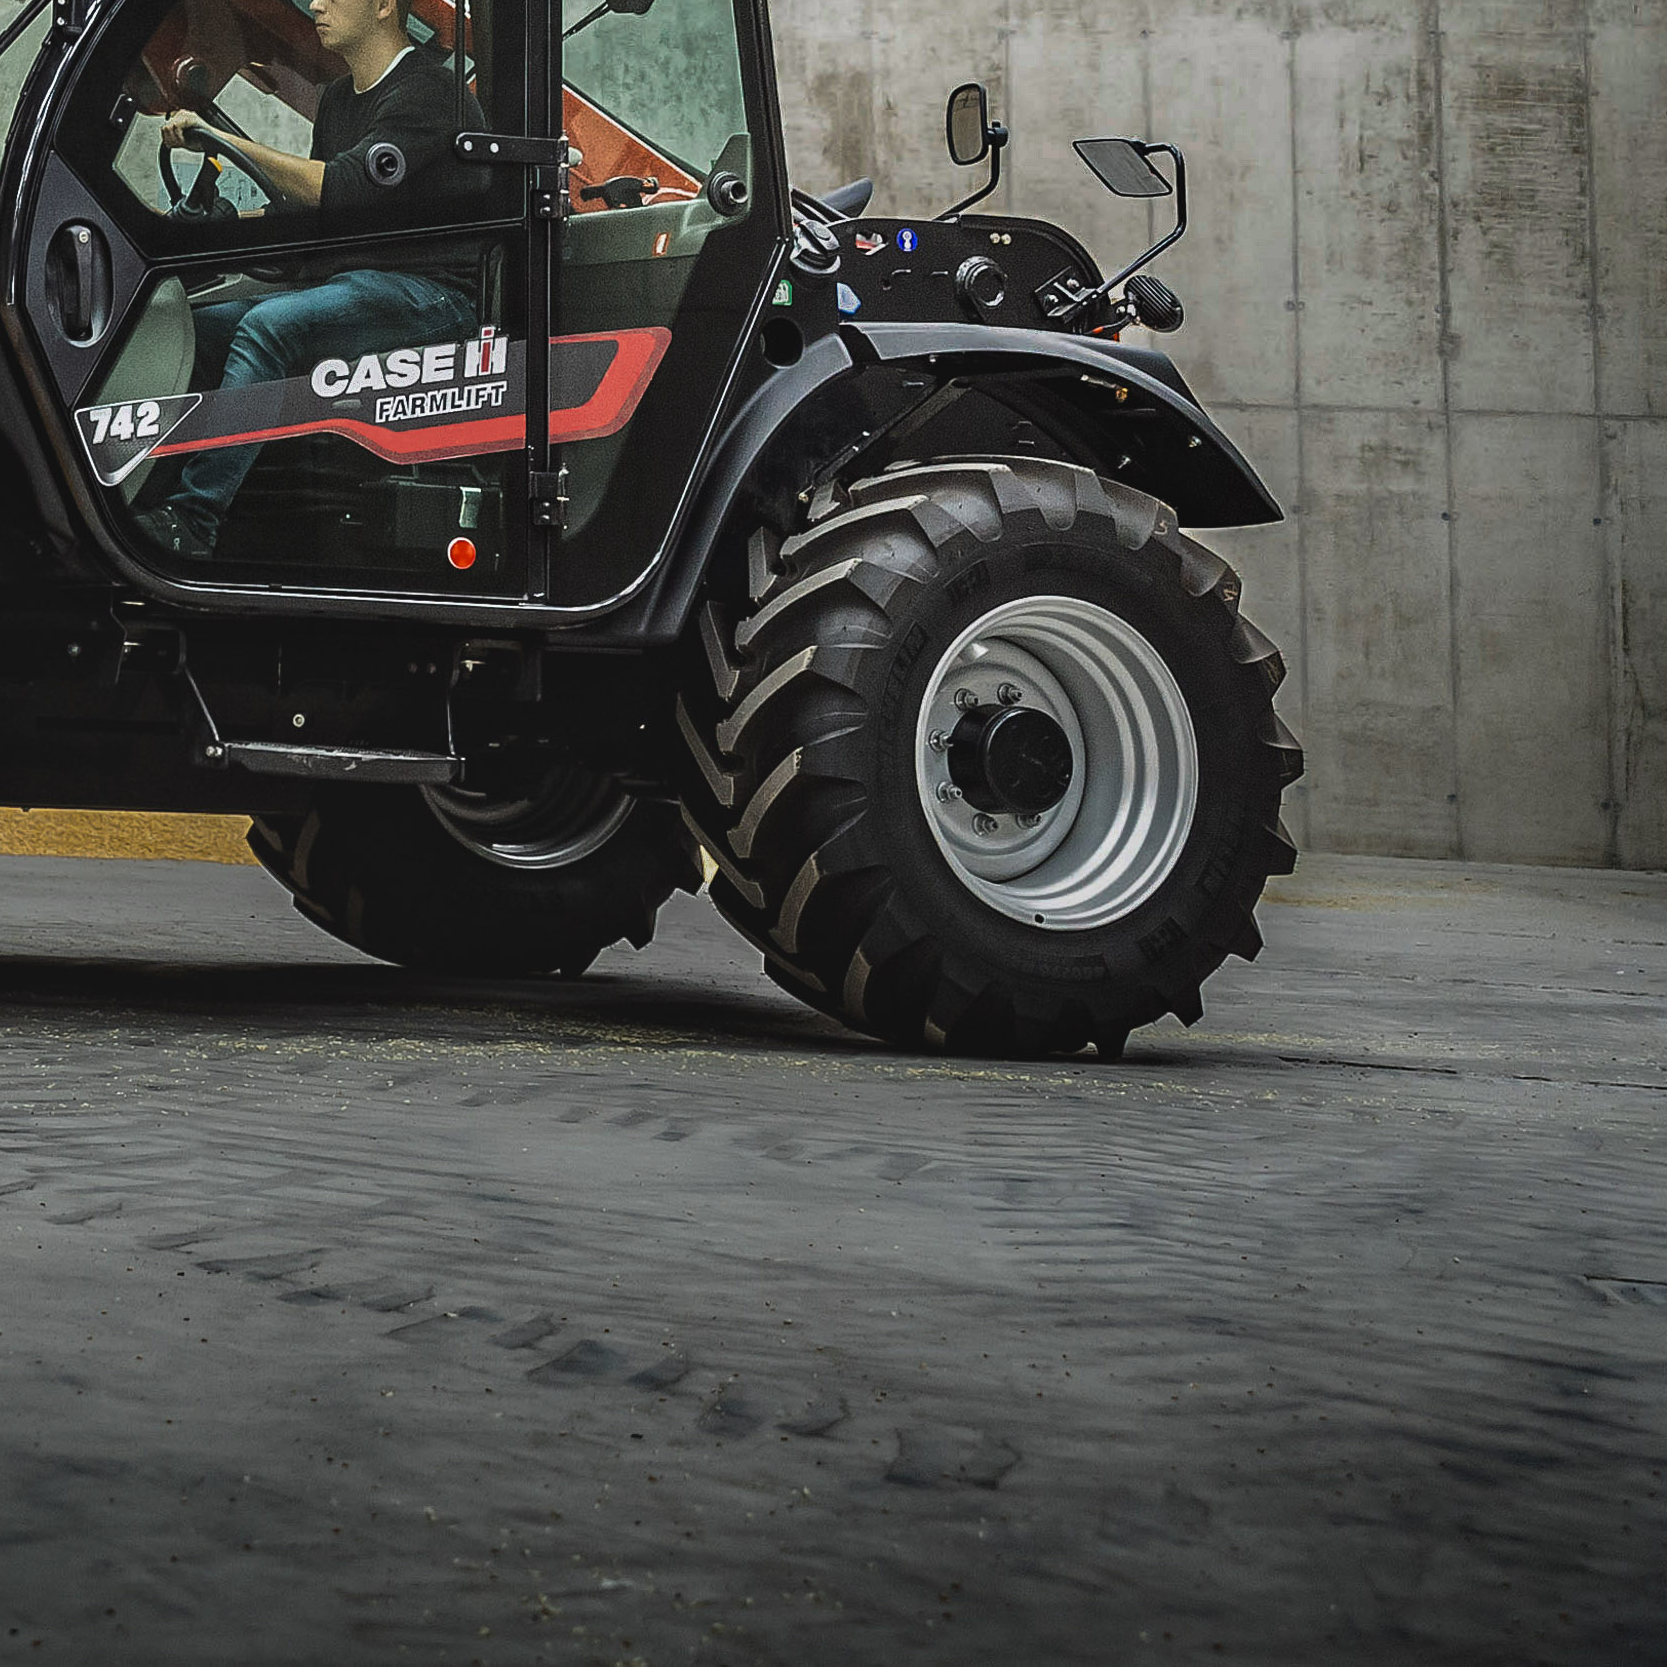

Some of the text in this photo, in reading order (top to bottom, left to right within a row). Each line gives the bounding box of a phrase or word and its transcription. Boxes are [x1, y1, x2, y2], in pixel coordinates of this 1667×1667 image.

[310, 342, 457, 398] CASE
[89, 401, 161, 445] 742
[375, 380, 507, 423] FARMLIFT
